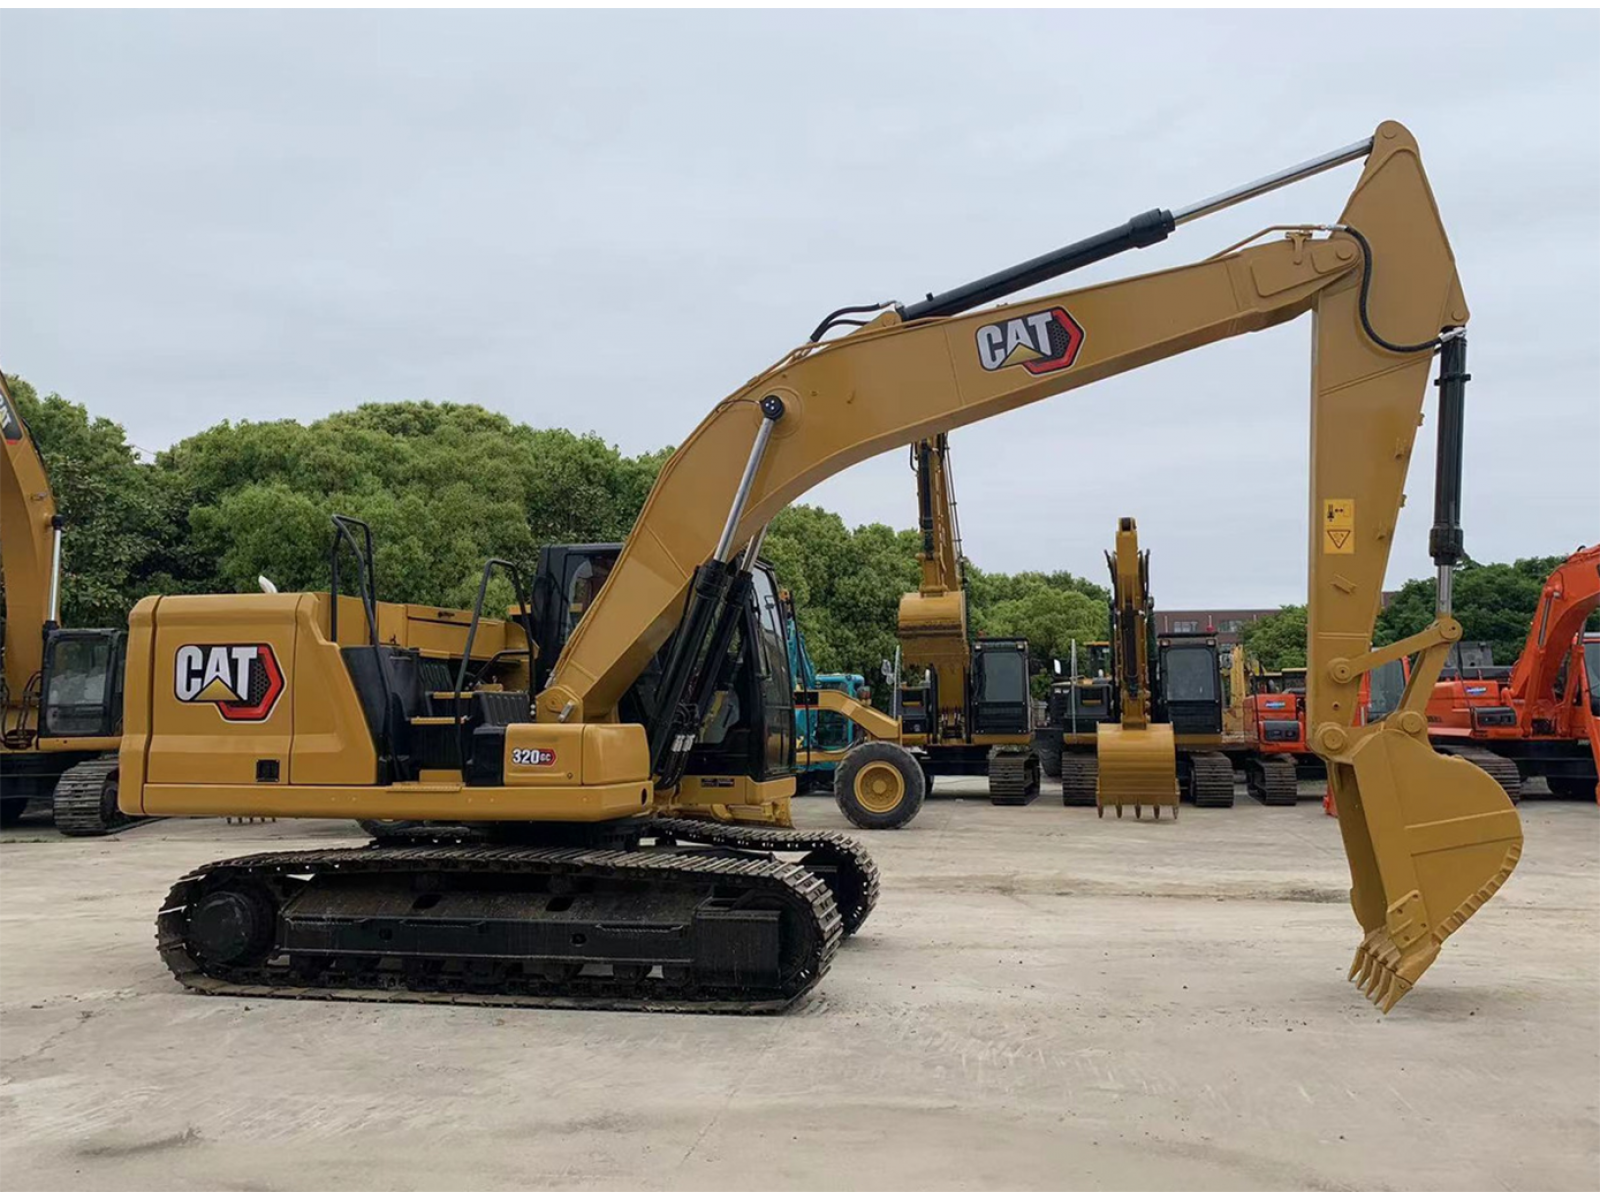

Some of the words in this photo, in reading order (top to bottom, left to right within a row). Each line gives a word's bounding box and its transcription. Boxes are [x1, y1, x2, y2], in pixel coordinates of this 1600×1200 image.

[977, 311, 1053, 370] CAT
[176, 645, 257, 701] CAT
[512, 748, 540, 764] 320
